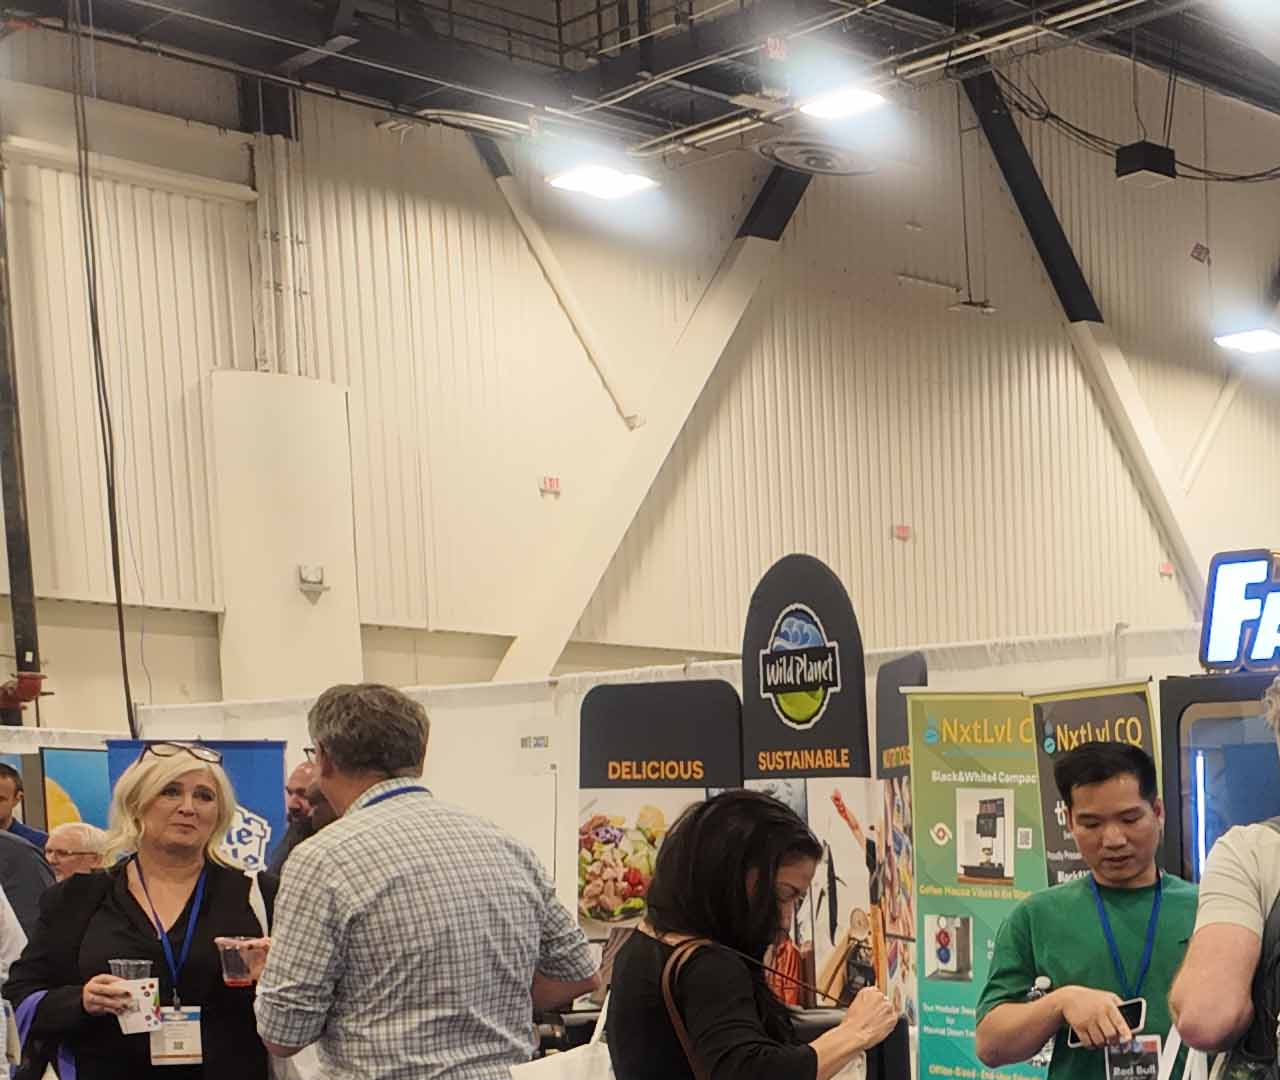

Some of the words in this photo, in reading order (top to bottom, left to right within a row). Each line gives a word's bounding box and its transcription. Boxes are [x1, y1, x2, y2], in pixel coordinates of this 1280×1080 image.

[766, 655, 794, 686] Wild
[796, 653, 833, 686] Planet
[941, 716, 1012, 744] NxtLvl
[607, 759, 705, 781] DELICIOUS
[757, 748, 850, 771] SUSTAINABLE
[998, 772, 1040, 786] Compac
[1112, 1066, 1134, 1076] Red
[1135, 1064, 1156, 1076] Bull
